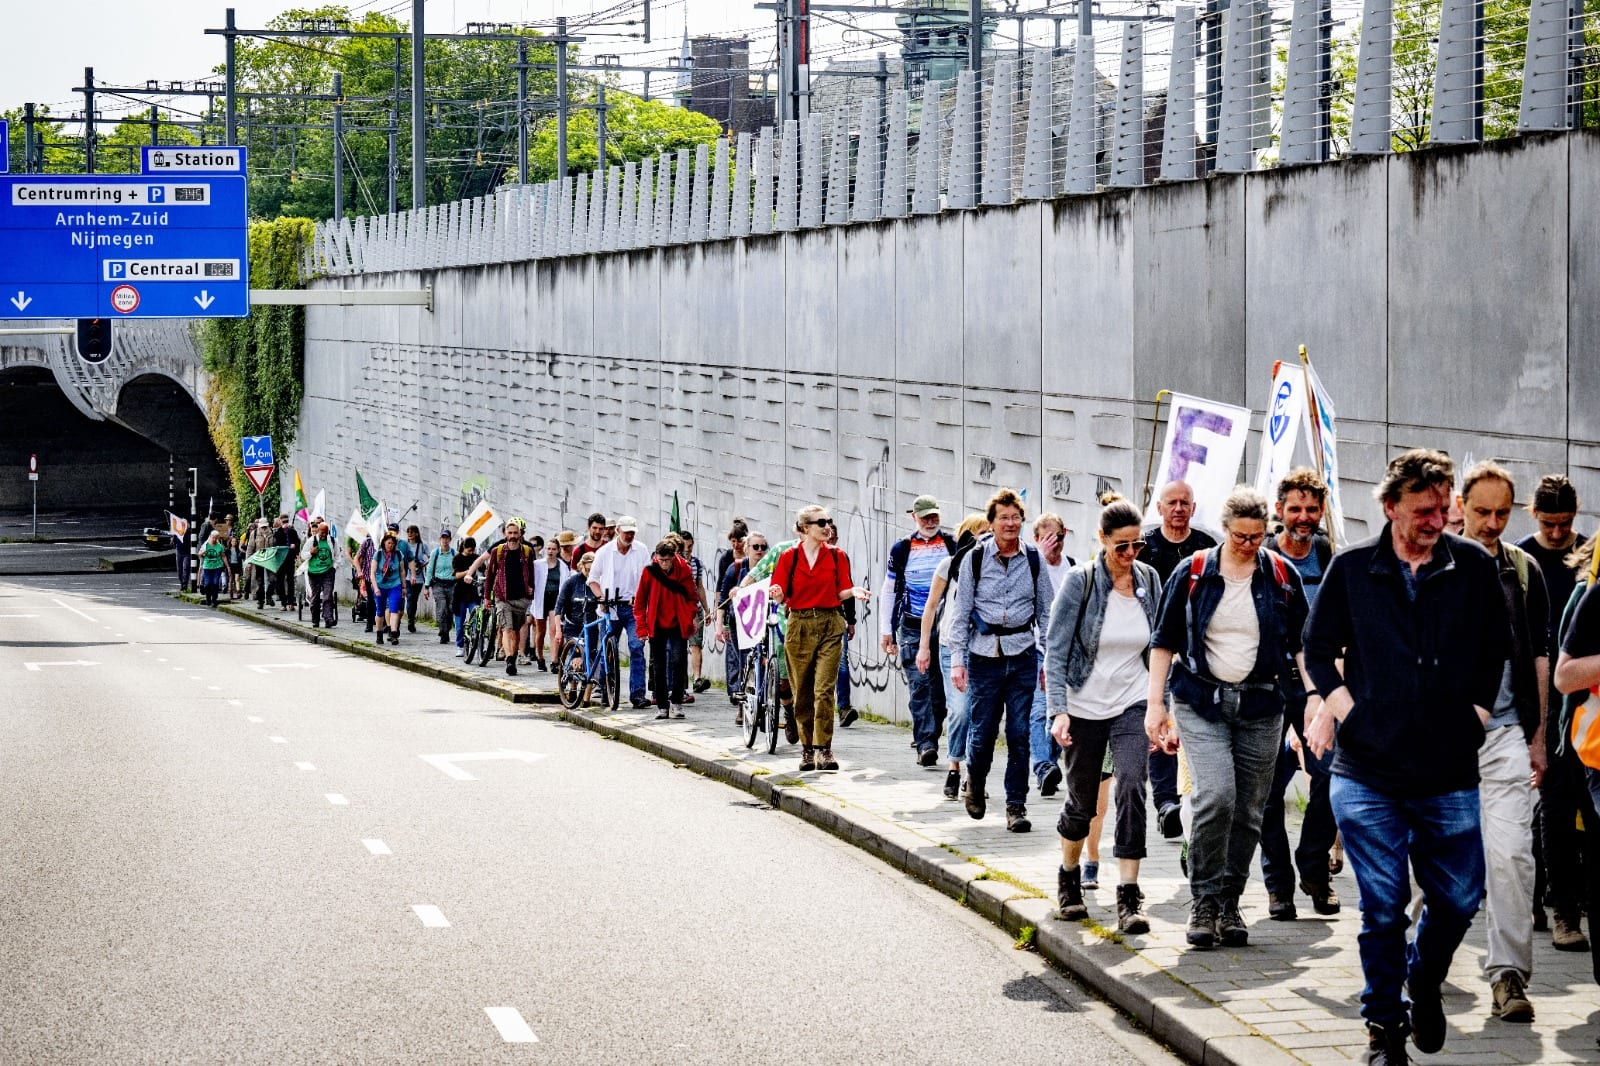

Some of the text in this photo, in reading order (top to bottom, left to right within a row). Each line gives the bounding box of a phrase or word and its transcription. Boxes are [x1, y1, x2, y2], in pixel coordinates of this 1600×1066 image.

[175, 153, 235, 166] Station
[17, 187, 122, 203] Centrumring
[152, 188, 162, 200] P
[55, 212, 169, 226] Arnhem-Zuid
[71, 232, 154, 248] Nijmegen
[112, 263, 199, 275] P Centraal
[1168, 406, 1234, 482] F
